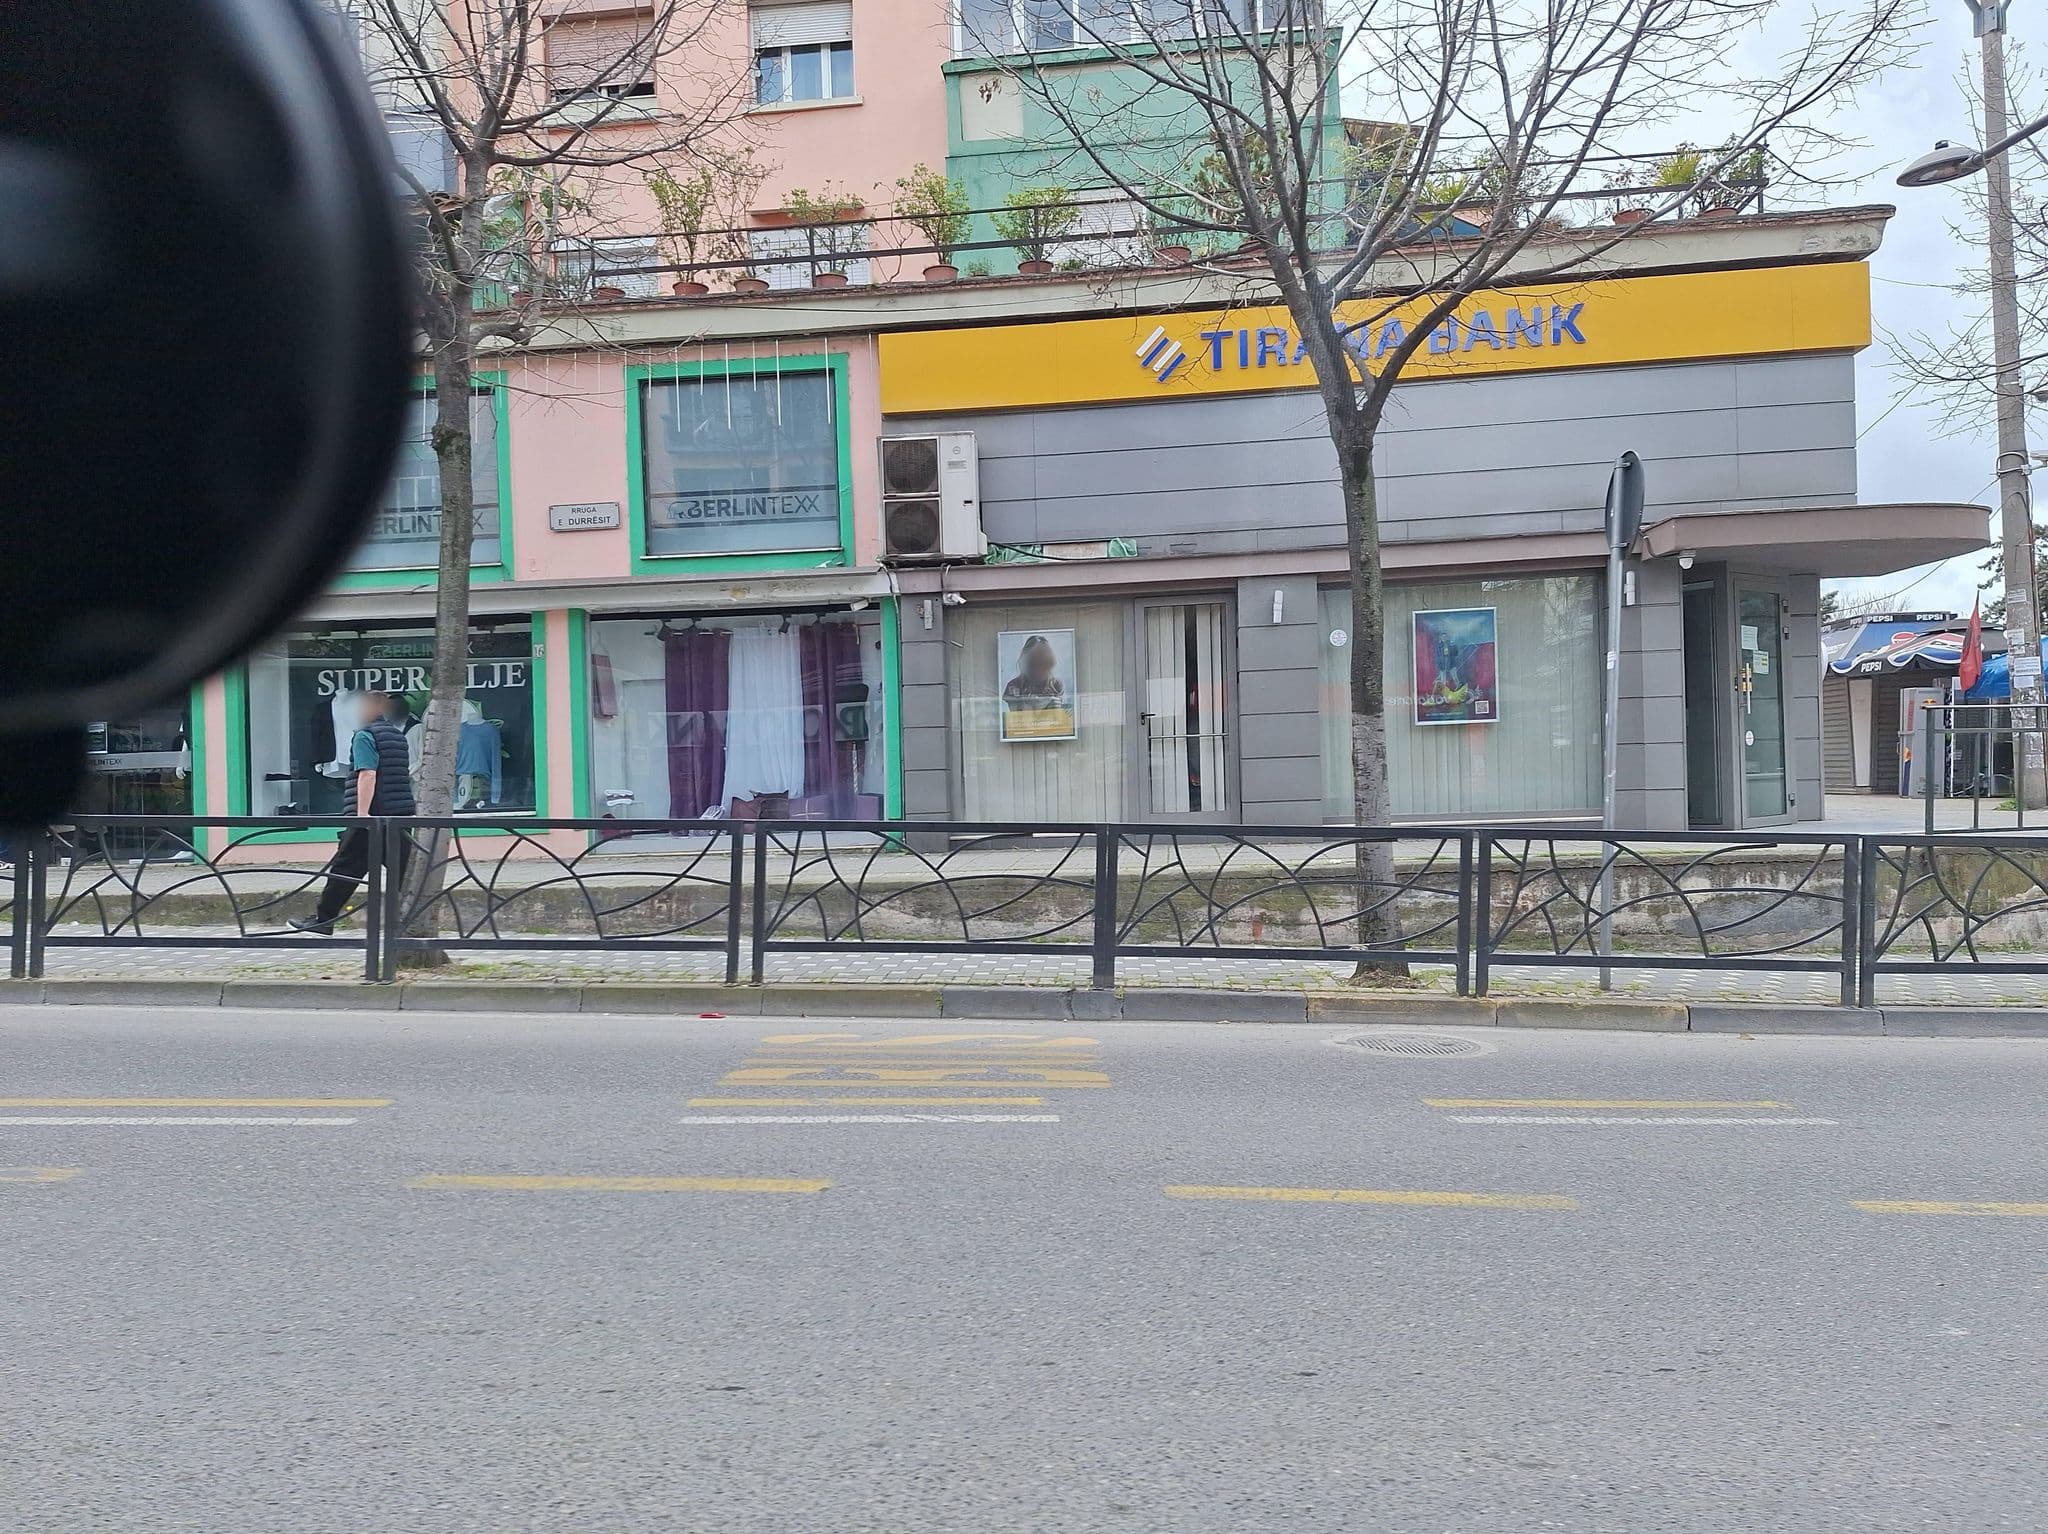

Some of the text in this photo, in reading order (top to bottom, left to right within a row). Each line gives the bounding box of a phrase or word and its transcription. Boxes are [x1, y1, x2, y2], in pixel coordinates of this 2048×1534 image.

[1429, 303, 1587, 355] BANK
[687, 494, 820, 519] BERLINTEXX
[1866, 614, 1894, 622] PEPSI
[1916, 612, 1943, 621] PEPSI
[1860, 660, 1883, 673] PEPSI
[317, 661, 527, 696] SUPER LJE
